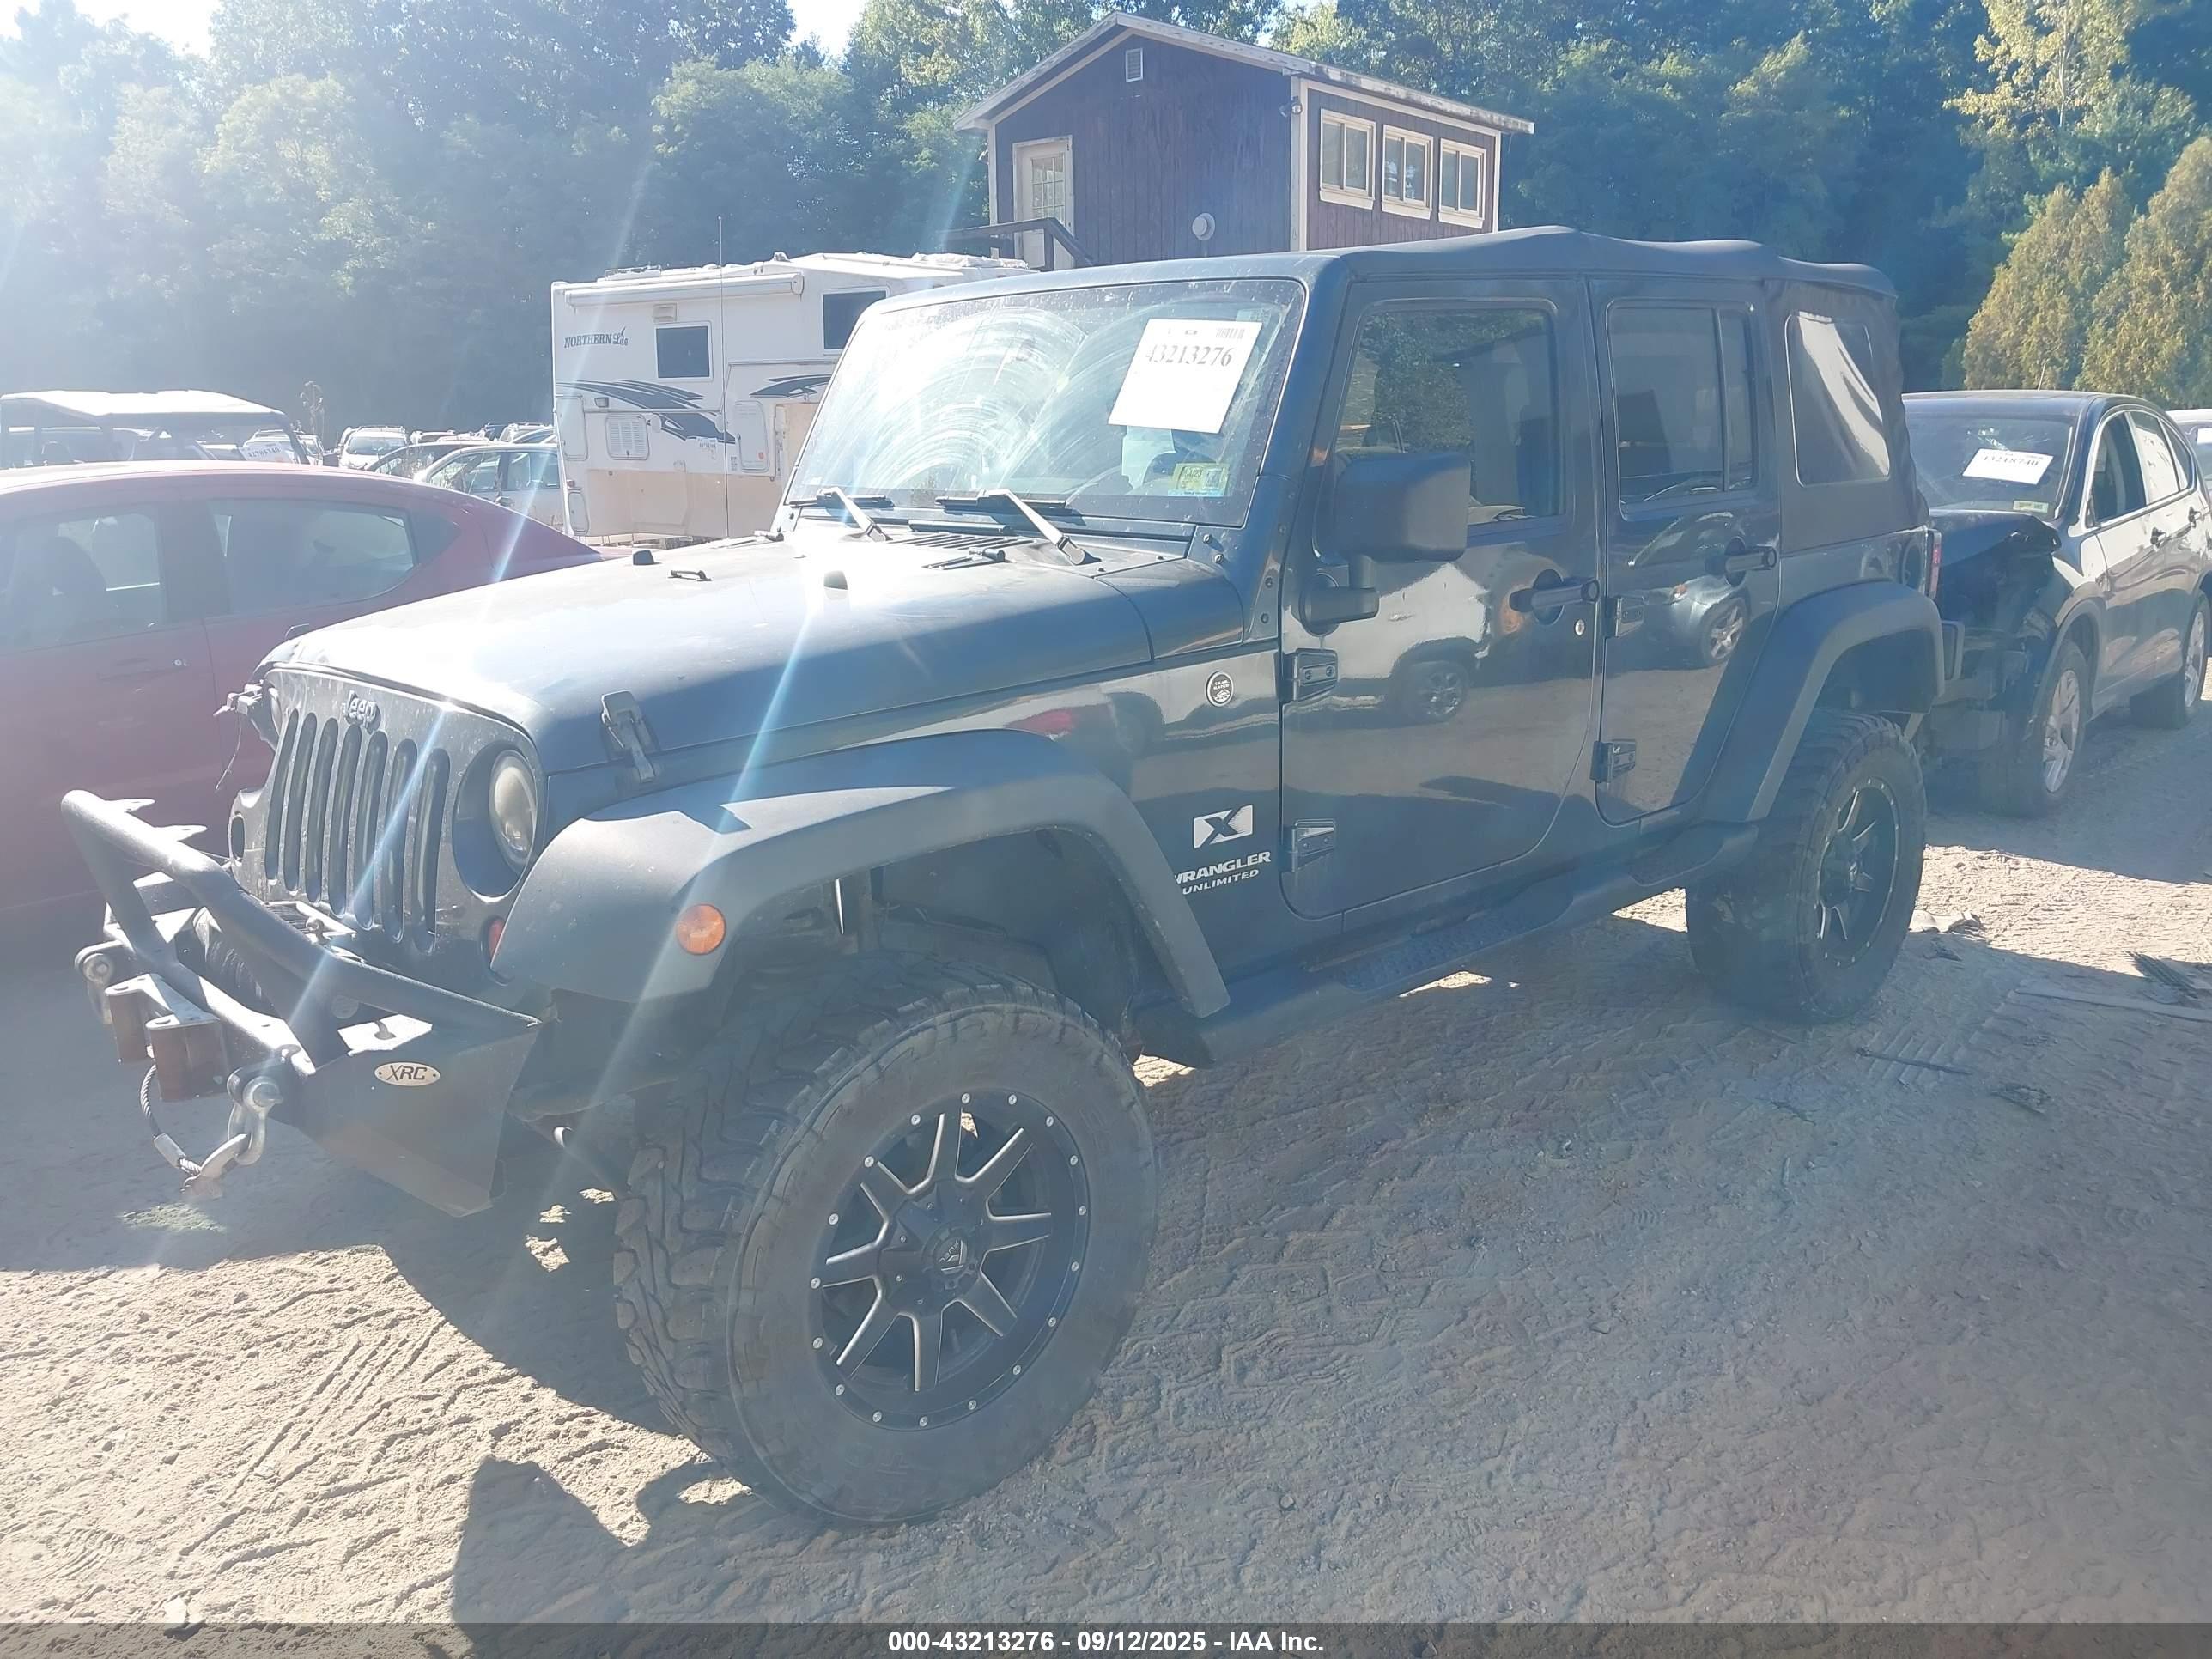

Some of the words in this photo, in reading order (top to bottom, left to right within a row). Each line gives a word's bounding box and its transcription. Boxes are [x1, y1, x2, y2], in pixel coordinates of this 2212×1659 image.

[564, 333, 612, 348] NORTHERN
[1145, 343, 1235, 368] 43213276
[342, 690, 377, 728] Jeep
[1182, 869, 1259, 895] UNLIMITED
[386, 1064, 428, 1081] XRC
